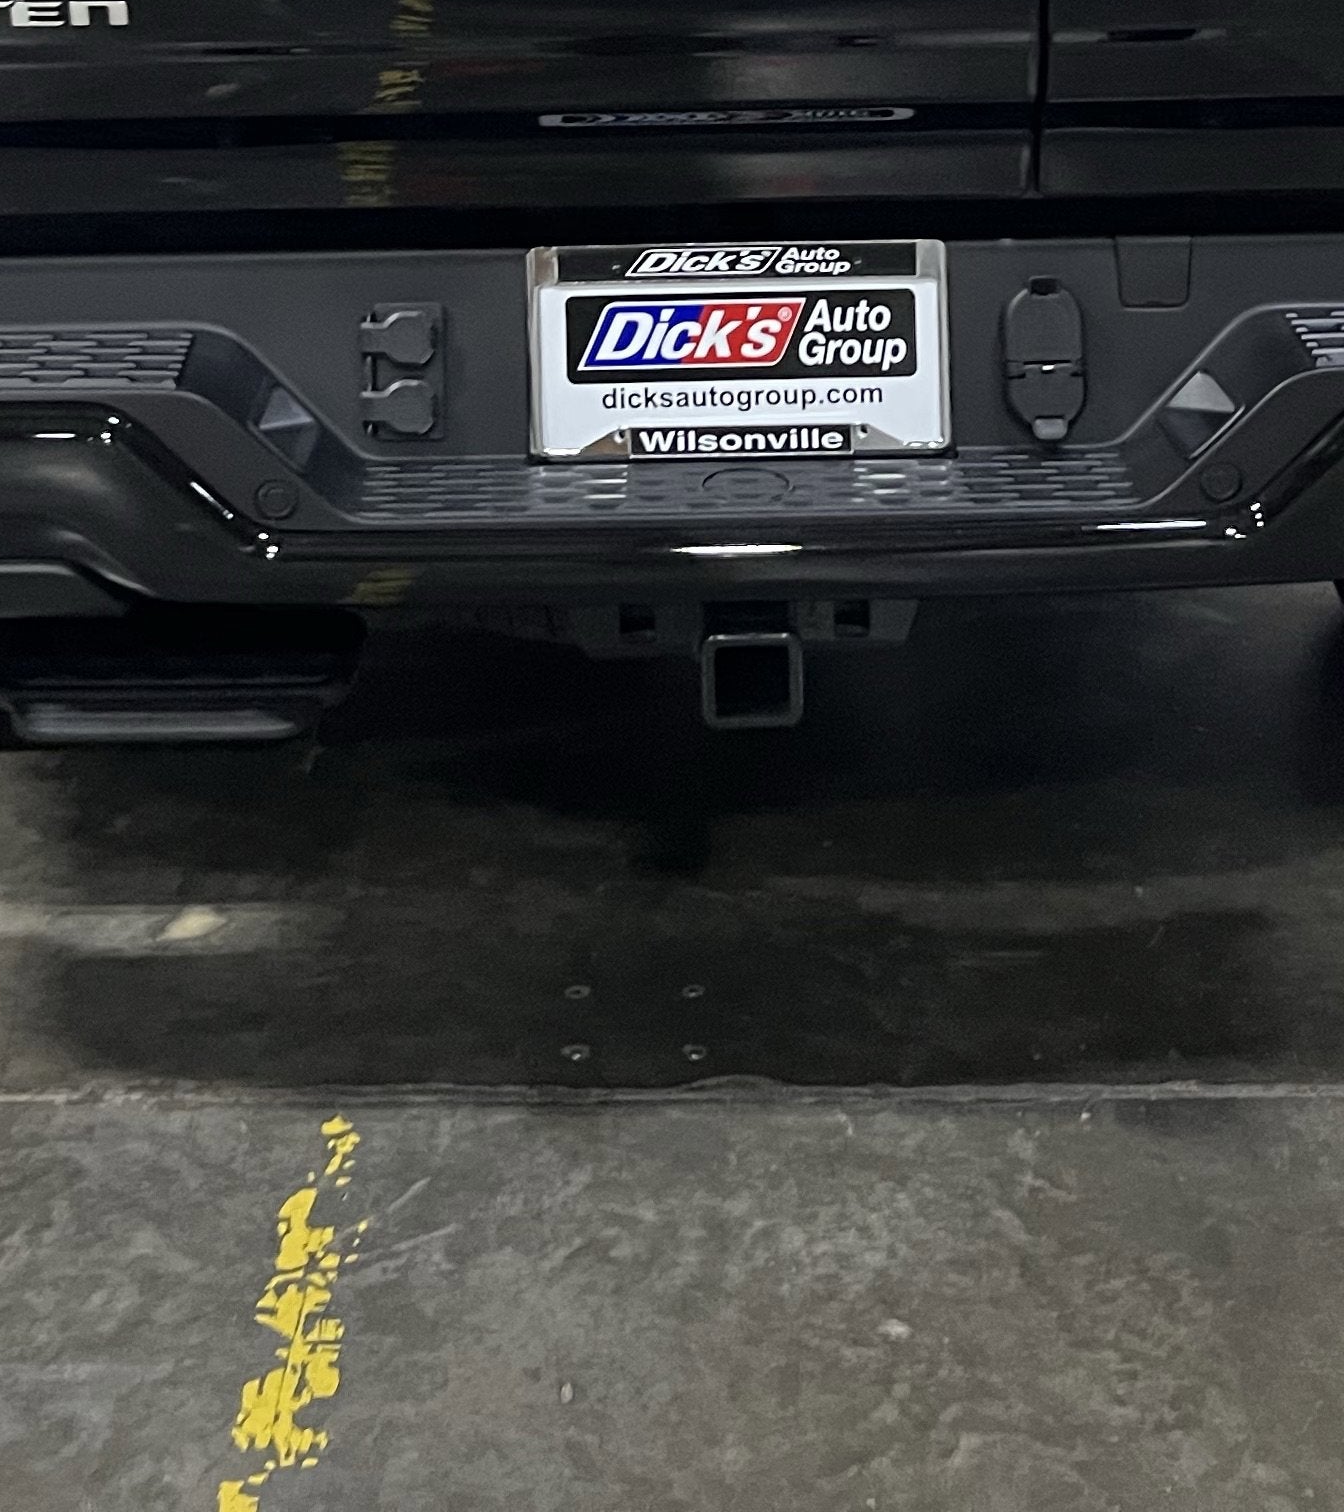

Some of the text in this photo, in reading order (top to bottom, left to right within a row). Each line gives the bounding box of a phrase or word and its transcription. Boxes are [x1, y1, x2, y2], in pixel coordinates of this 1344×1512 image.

[780, 247, 841, 261] Auto
[775, 260, 852, 275] Group
[804, 299, 892, 332] Auto
[799, 332, 907, 371] Group
[602, 387, 883, 411] dicksautogroup.com
[639, 428, 844, 452] Wilsonville
